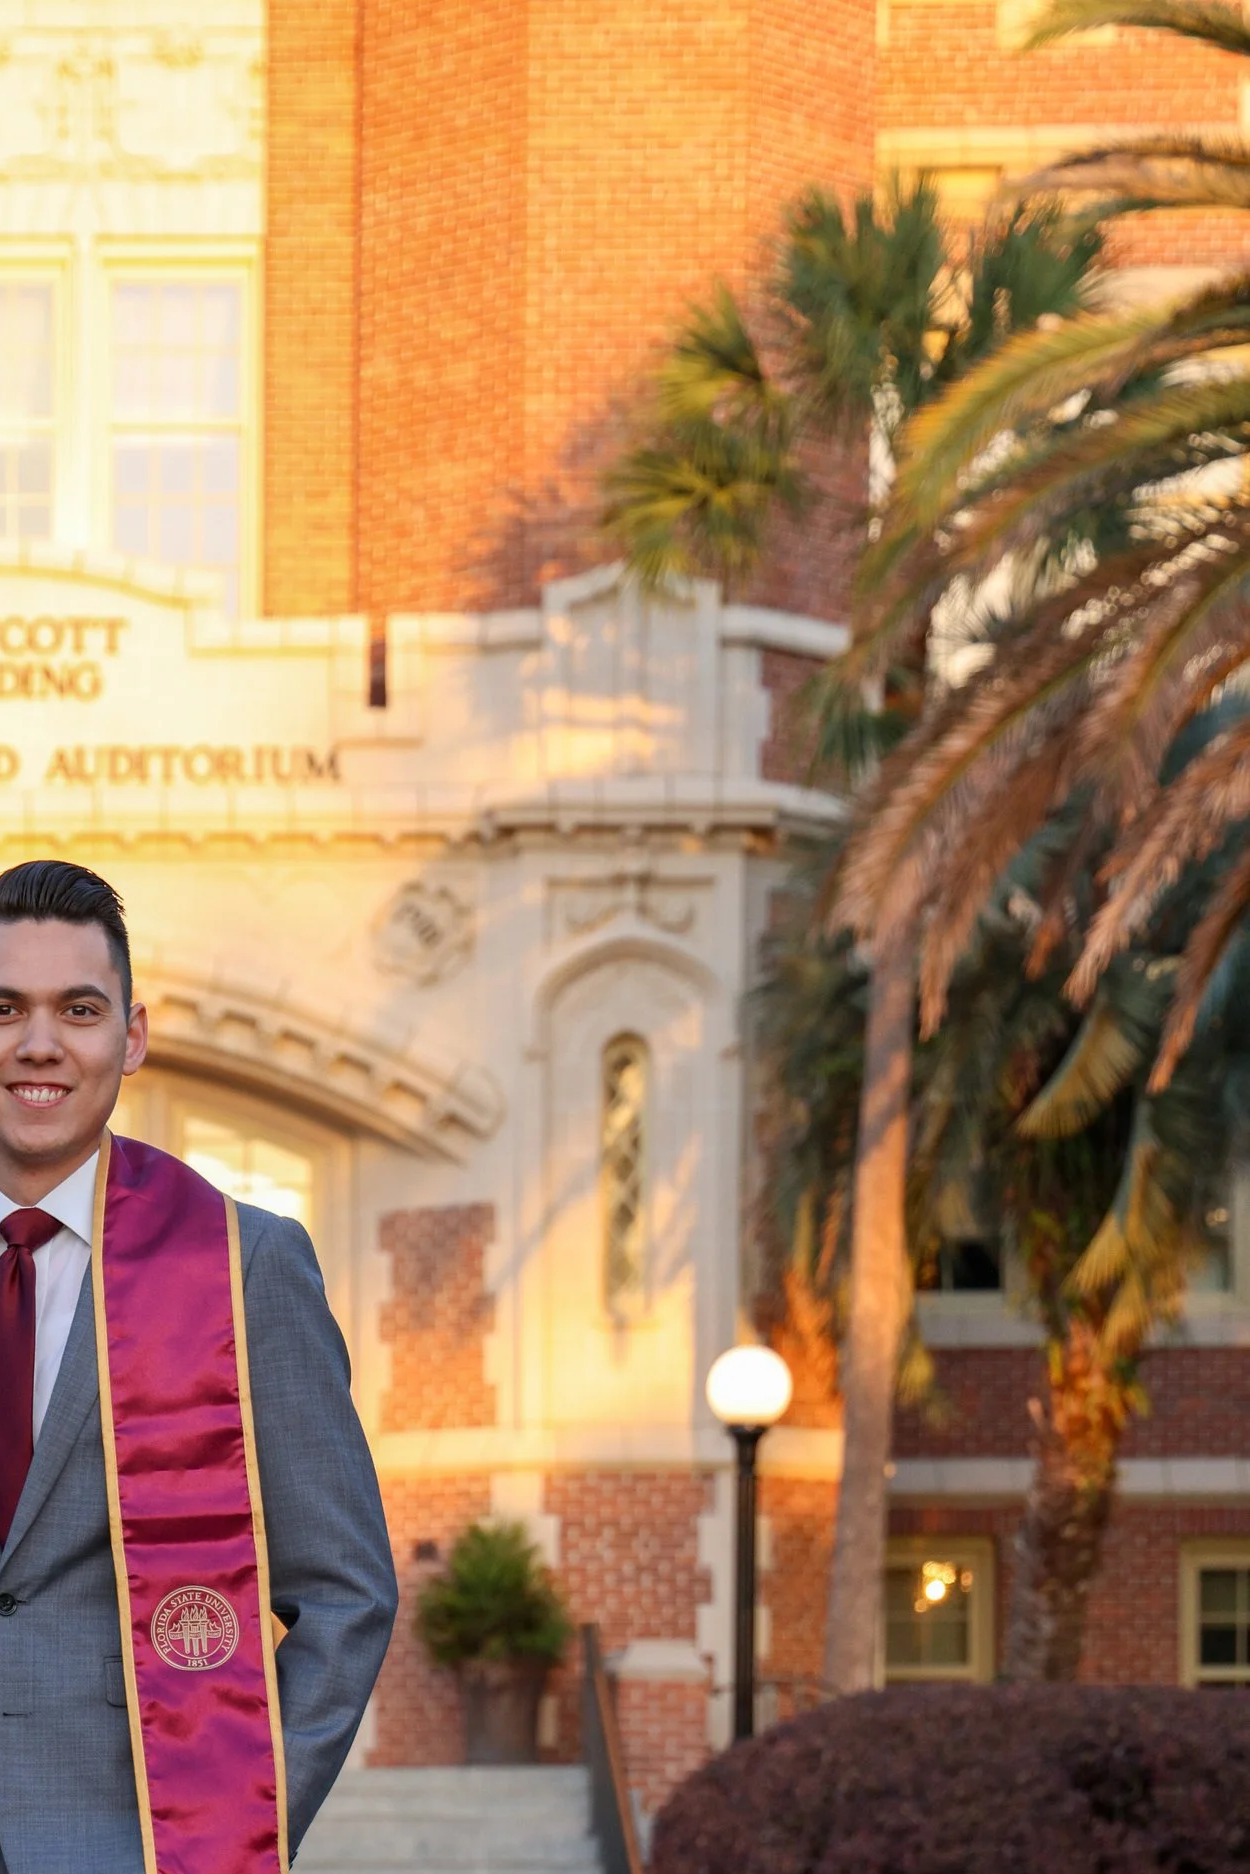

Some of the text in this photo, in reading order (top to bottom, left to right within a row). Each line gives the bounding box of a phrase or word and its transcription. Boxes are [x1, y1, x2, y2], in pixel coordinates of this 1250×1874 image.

[46, 744, 342, 785] AUDITORIUM
[156, 1592, 234, 1654] FLORIDA STATE UNIVERSITY
[187, 1658, 208, 1668] 1851
